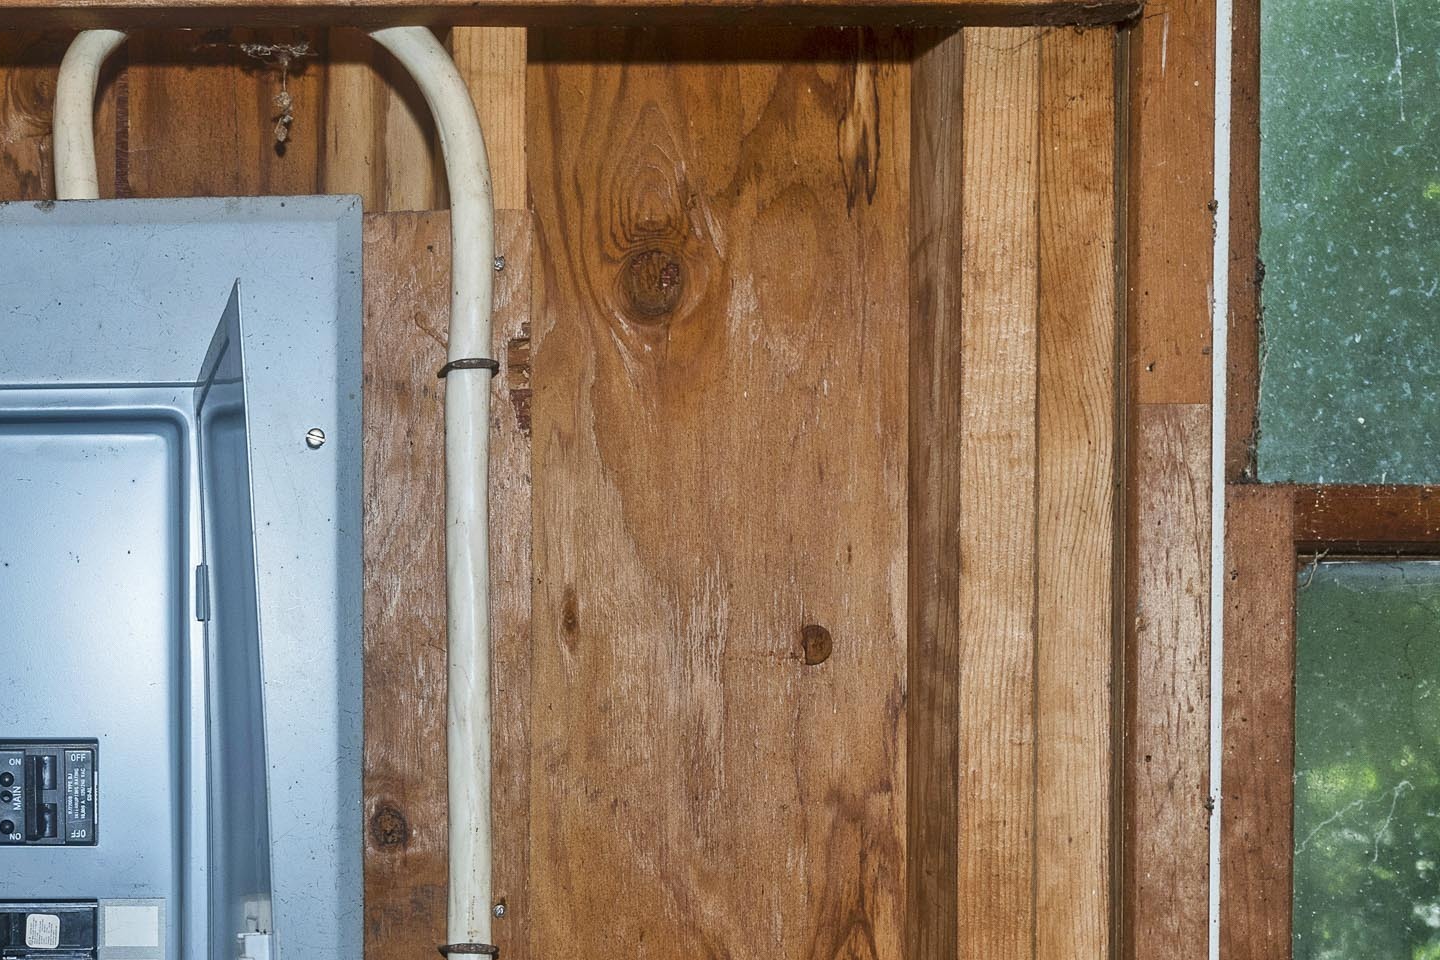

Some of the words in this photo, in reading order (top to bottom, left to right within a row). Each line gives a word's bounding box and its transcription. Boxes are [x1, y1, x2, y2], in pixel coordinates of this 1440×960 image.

[8, 758, 22, 766] ON
[71, 753, 86, 762] OFF
[13, 786, 22, 811] MAIN
[9, 832, 22, 840] ON
[71, 829, 86, 838] OFF
